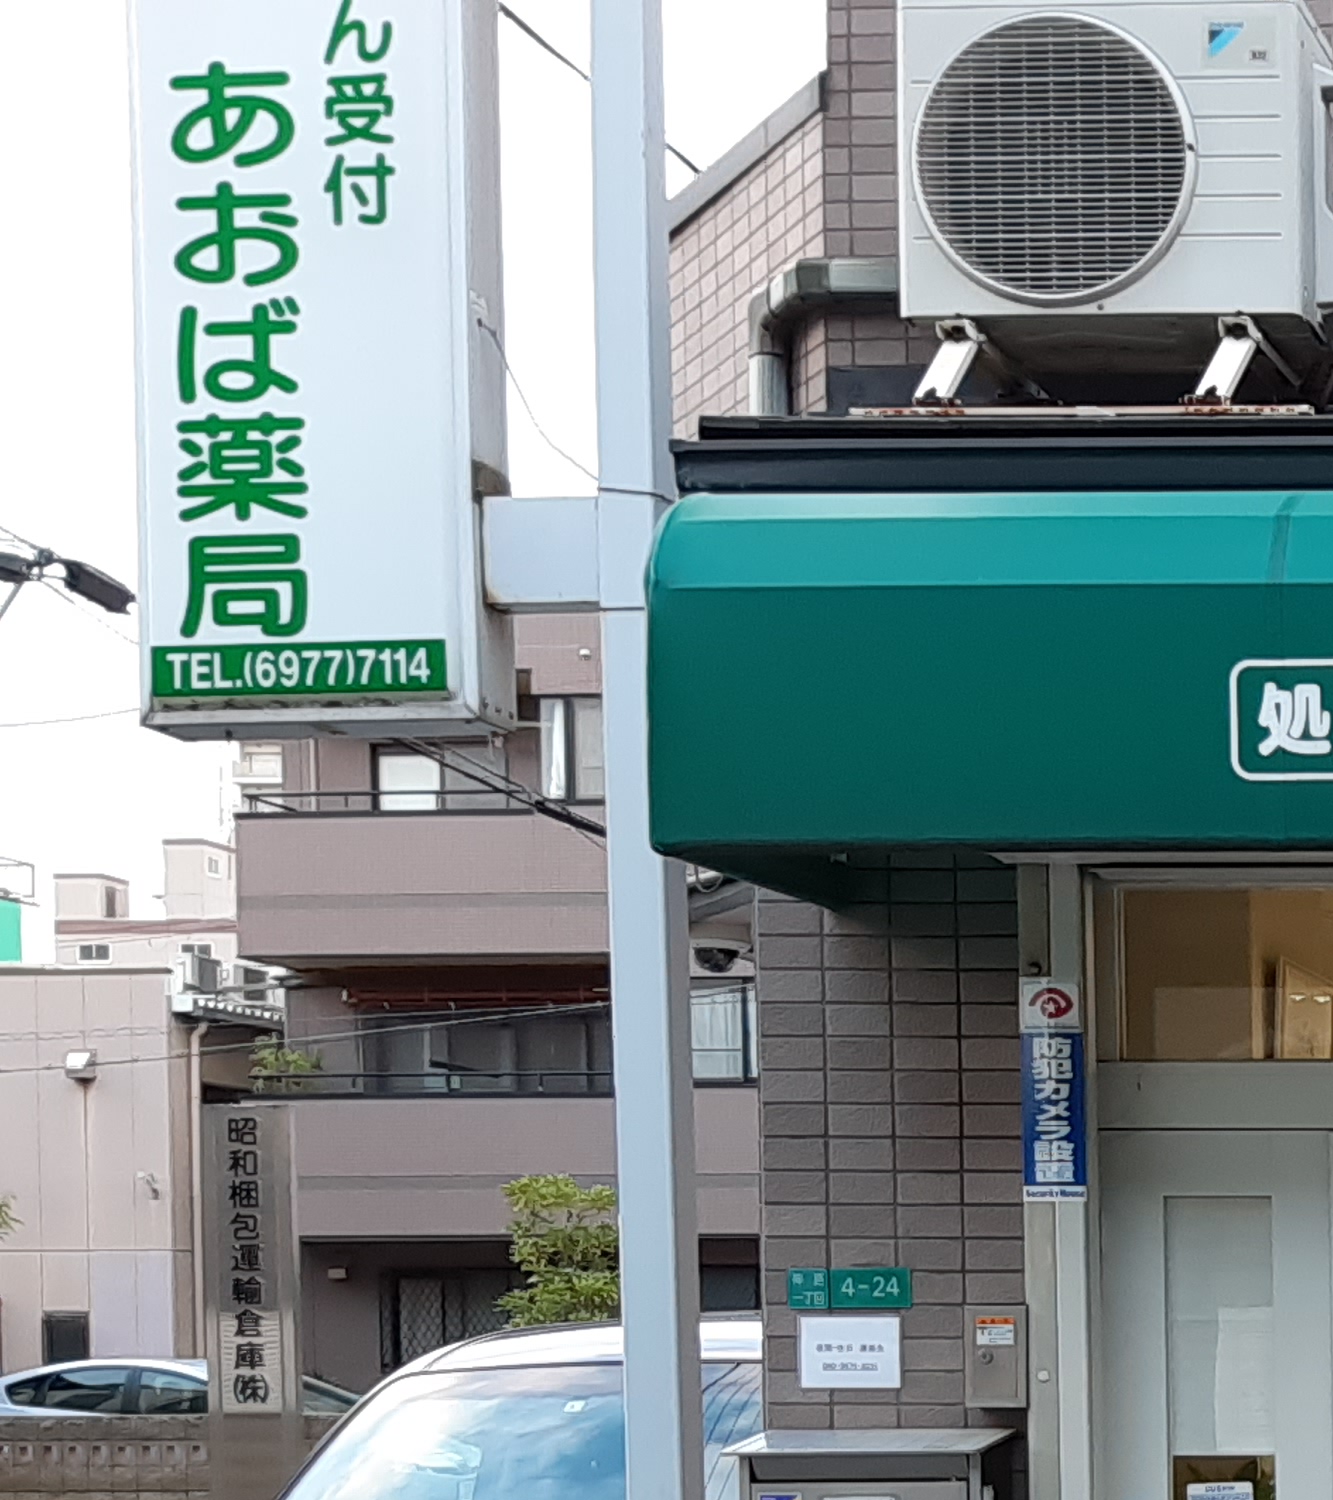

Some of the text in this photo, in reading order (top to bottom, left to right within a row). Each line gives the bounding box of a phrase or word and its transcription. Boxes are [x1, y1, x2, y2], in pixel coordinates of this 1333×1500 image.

[168, 61, 309, 638] あおば薬局
[166, 646, 431, 691] TEL.(6977)7114
[1031, 1036, 1075, 1182] 防犯カメラ設置
[840, 1276, 900, 1298] 4-24
